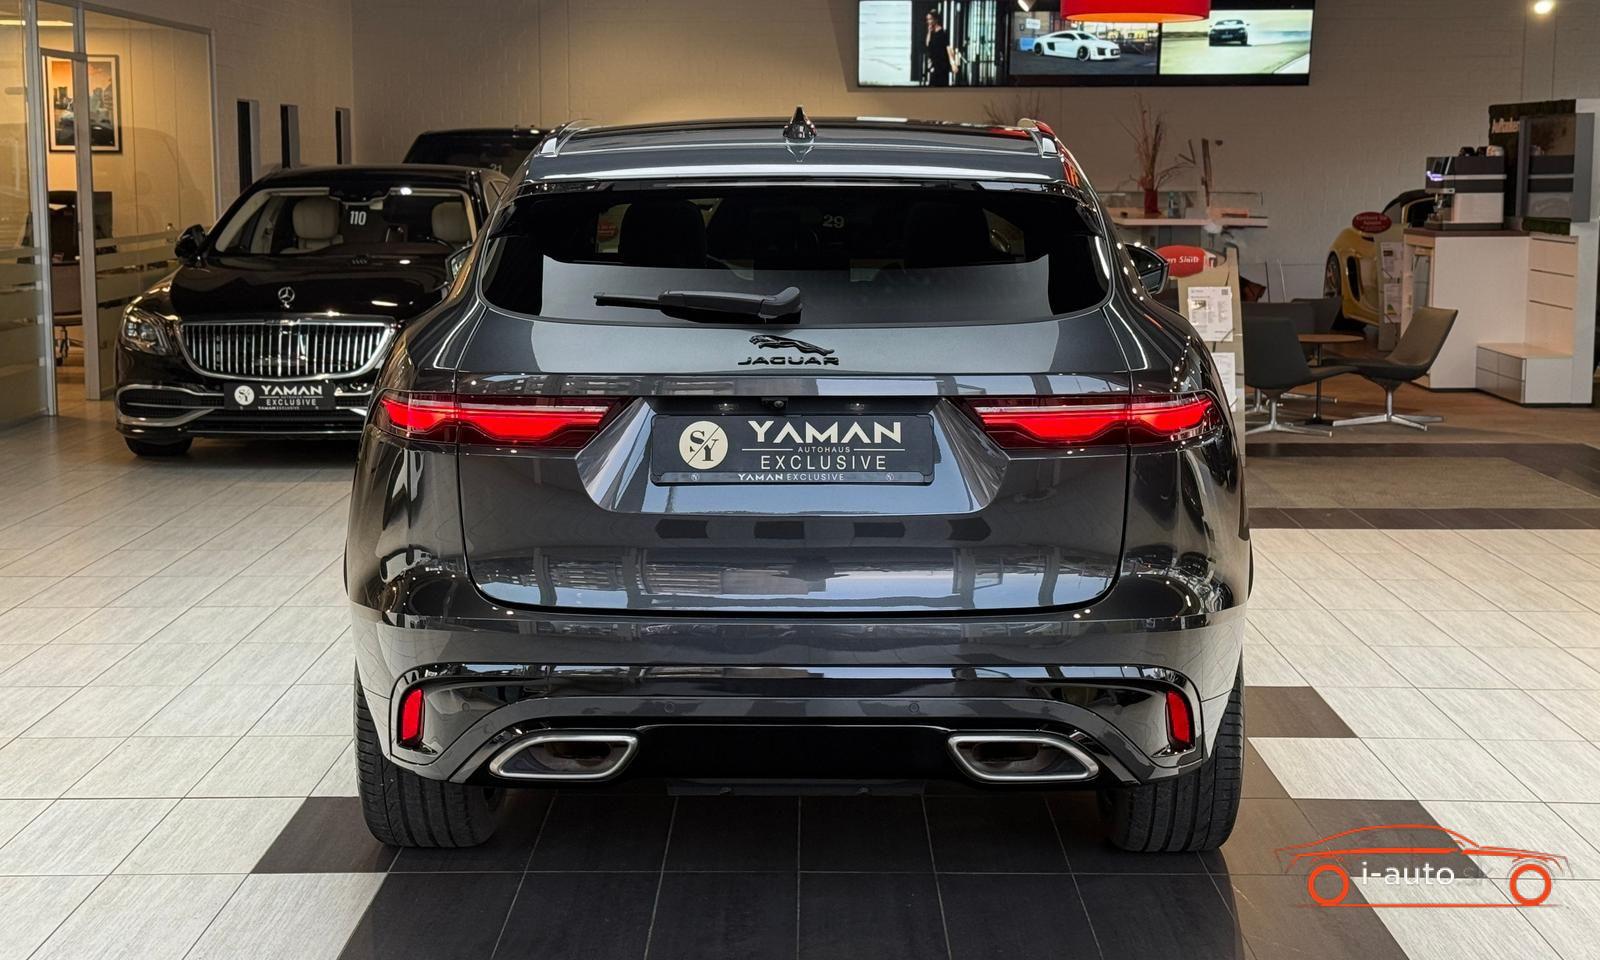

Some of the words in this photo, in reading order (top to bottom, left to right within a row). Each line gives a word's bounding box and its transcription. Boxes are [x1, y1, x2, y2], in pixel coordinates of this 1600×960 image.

[350, 211, 366, 225] 110
[822, 214, 844, 228] 29
[738, 357, 838, 365] JAGUAR
[261, 385, 323, 395] YAMAN
[747, 420, 902, 444] YAMAN
[761, 455, 887, 470] EXCLUSIVE
[737, 473, 783, 481] YAMAN
[786, 473, 844, 481] EXCLUSIVE
